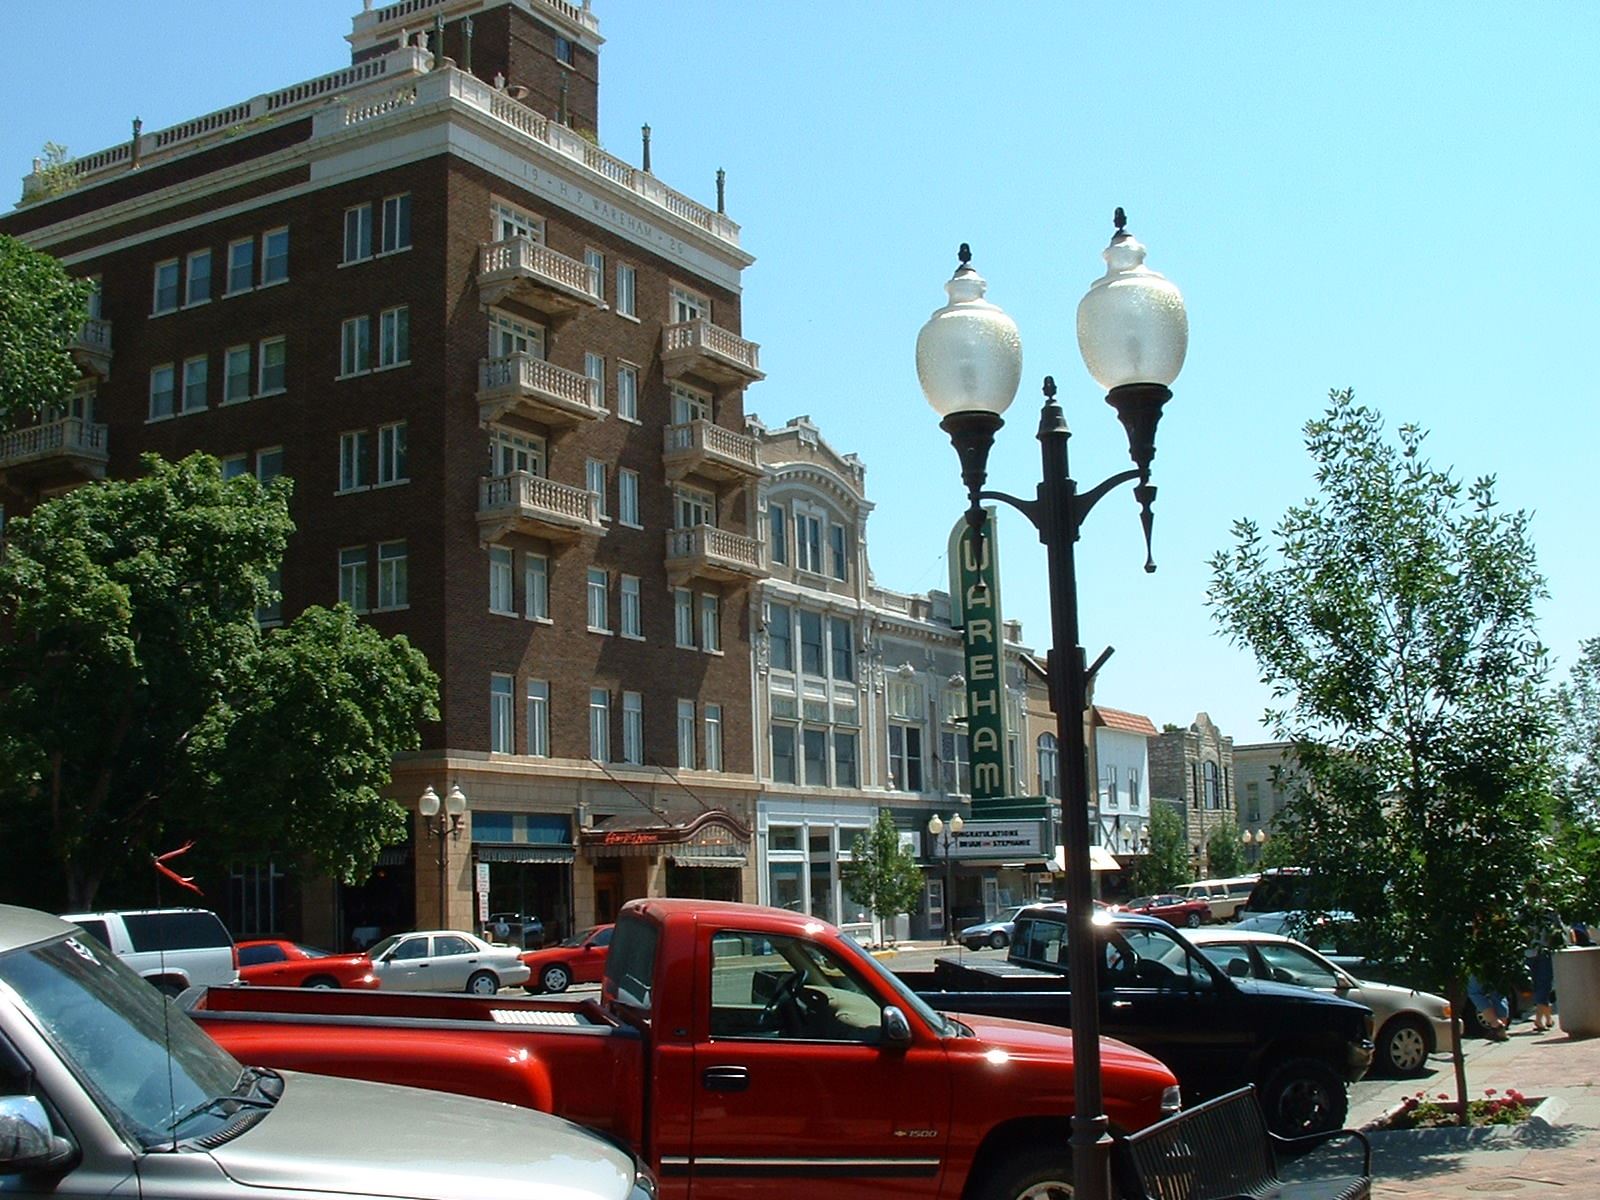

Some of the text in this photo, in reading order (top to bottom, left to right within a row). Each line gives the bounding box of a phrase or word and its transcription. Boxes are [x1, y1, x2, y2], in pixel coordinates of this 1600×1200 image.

[523, 163, 538, 181] 19
[592, 200, 652, 237] WAREHAM
[964, 537, 999, 795] WAREHAM
[909, 1130, 937, 1138] 1500
